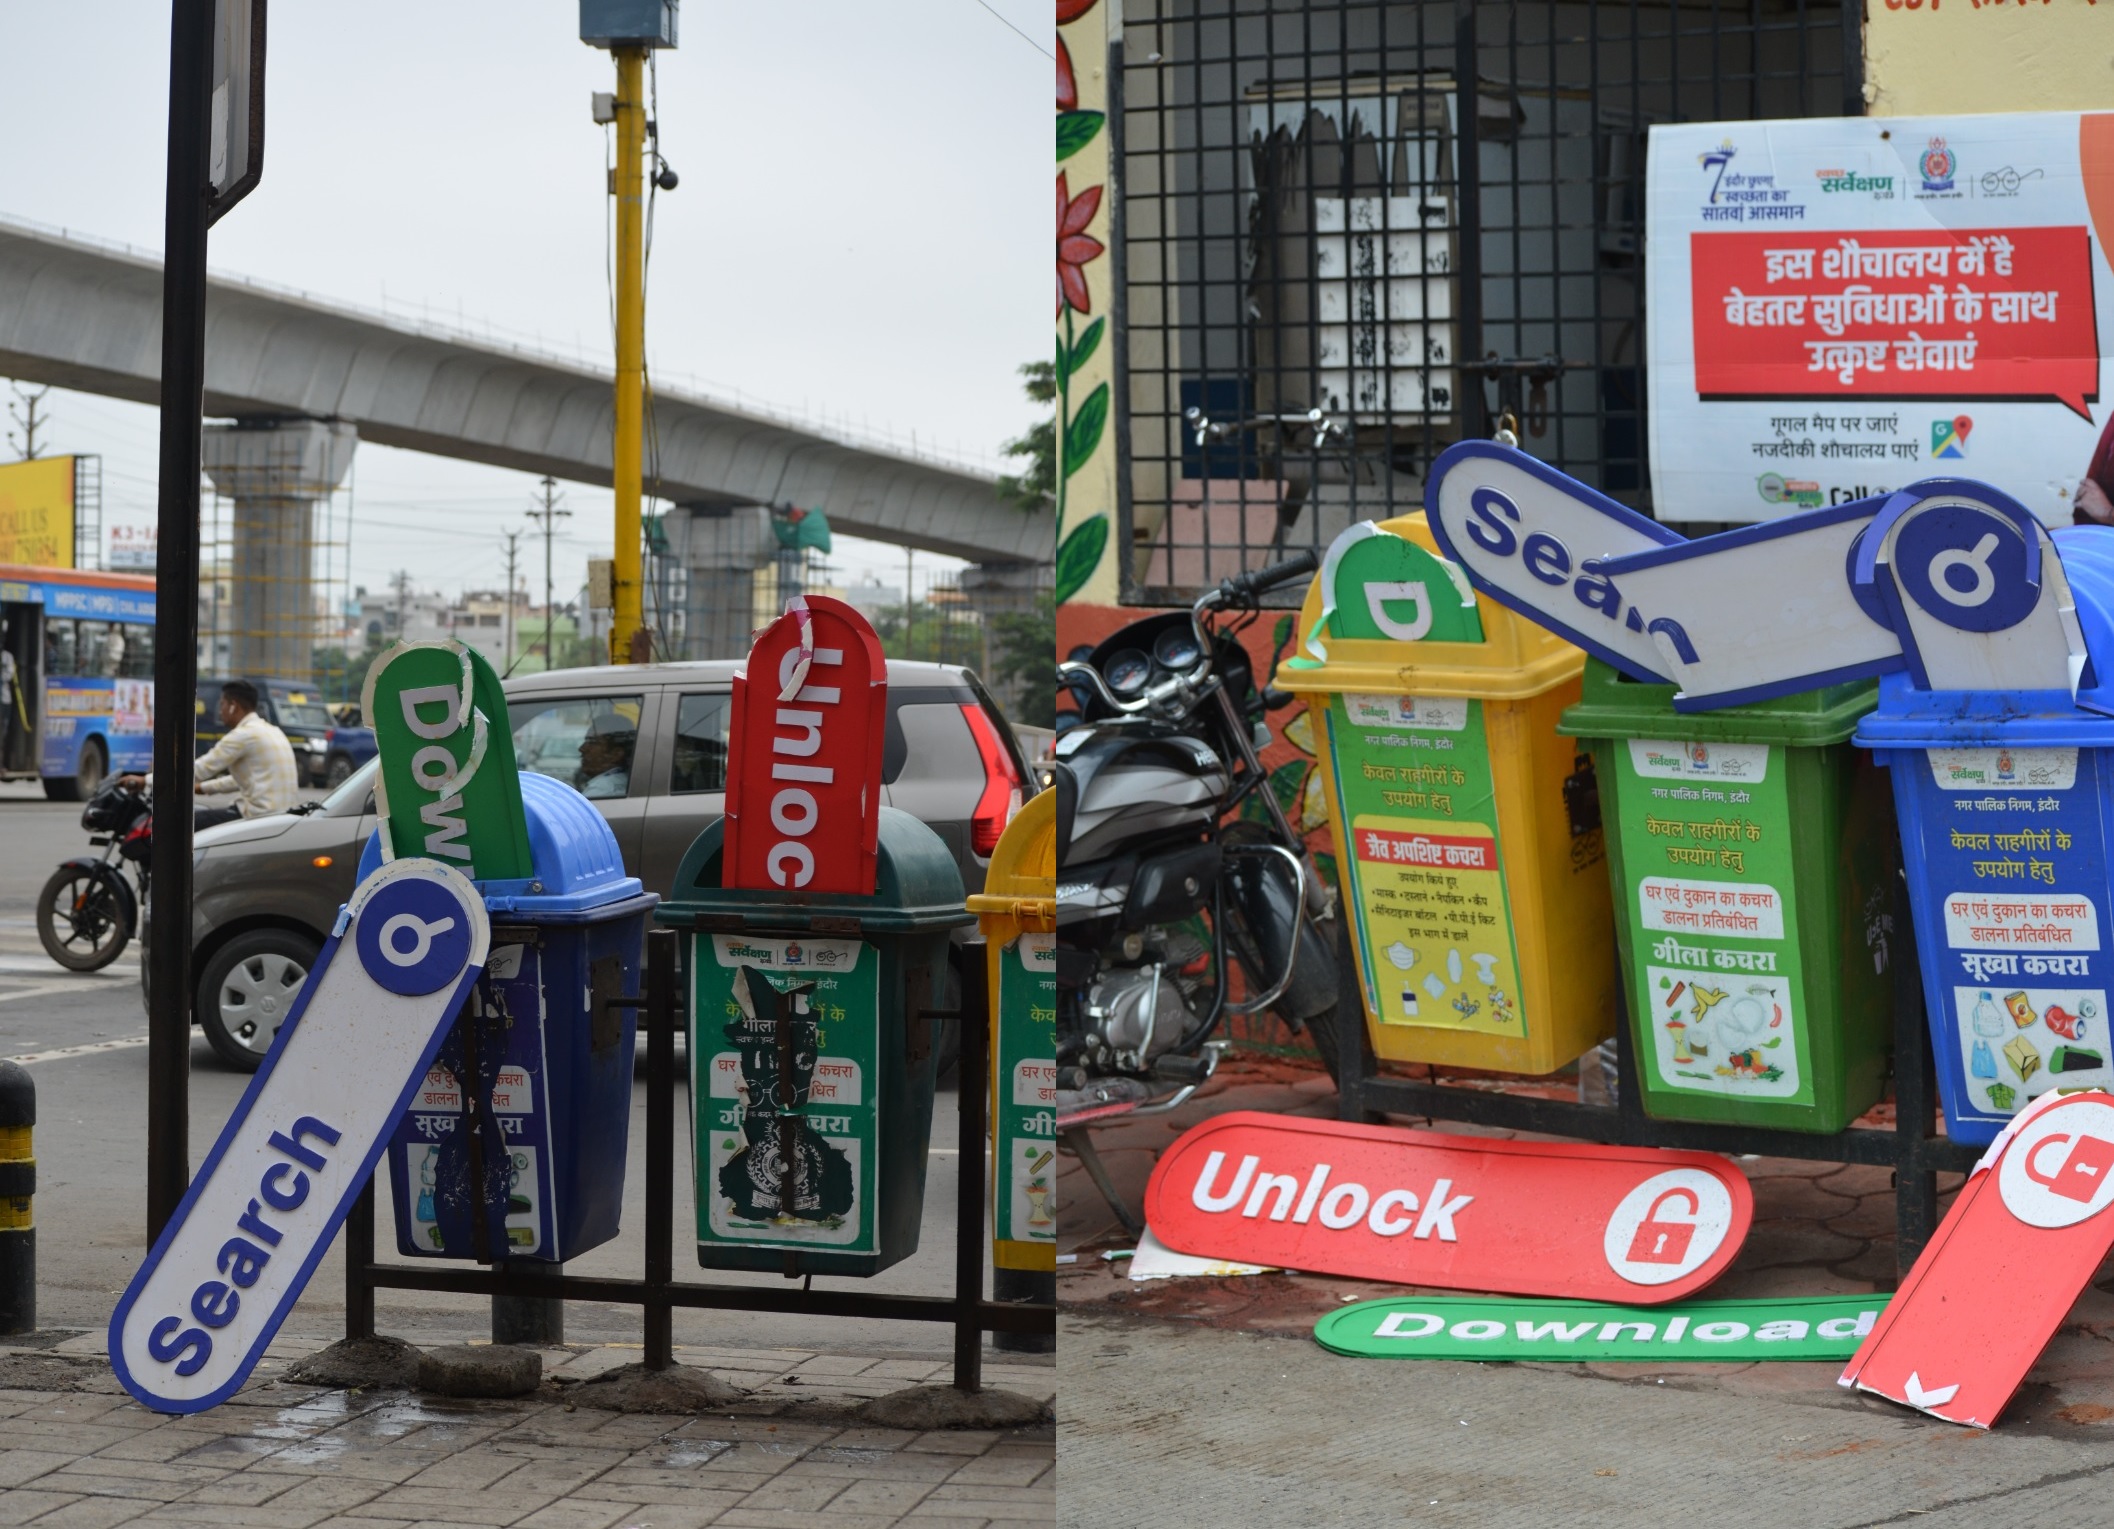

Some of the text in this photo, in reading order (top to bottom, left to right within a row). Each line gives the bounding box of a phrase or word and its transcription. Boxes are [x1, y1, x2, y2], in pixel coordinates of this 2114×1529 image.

[1821, 171, 1894, 193] सर्वेक्षण
[1771, 190, 1790, 202] का
[1748, 204, 1806, 220] आसमान
[1763, 235, 2015, 284] इस शौचालय में है
[1723, 283, 2059, 336] बेहतर सुविधाओं के साथ
[1804, 332, 1978, 385] उत्कृष्ट सेवाएं
[1770, 412, 1899, 436] गूगल मैप पर जाएं
[1752, 438, 1919, 461] नजदीकी शौचालय पाएं
[1361, 759, 1465, 786] केवल राहगीरों के
[1382, 788, 1453, 815] उपयोग हेतु
[1651, 788, 1668, 799] नगर
[1671, 786, 1700, 800] पालिक
[1730, 790, 1751, 804] इंदौर
[1954, 799, 1973, 811] नगर
[1975, 797, 2006, 812] पालिक
[2037, 797, 2060, 812] इंदौर
[1646, 813, 1761, 842] केवल राहगीरों के
[1951, 828, 2072, 852] केवल राहगीरों के
[1366, 833, 1485, 866] जैव अपशिष्ट कचरा
[1667, 844, 1745, 874] उपयोग हेतु
[1973, 857, 2056, 885] उपयोग हेतु
[1645, 884, 1773, 909] घर एवं दुकान का कचरा
[1662, 909, 1758, 931] डालना प्रतिबंधित
[1951, 898, 2087, 923] घर एवं दुकान का कचरा
[1970, 924, 2072, 944] डालना प्रतिबंधित
[1652, 936, 1777, 971] गीला कचरा
[1961, 952, 2089, 982] सूखा कचरा
[830, 1003, 846, 1022] के
[718, 1059, 853, 1078] घर कचरा
[1021, 1066, 1039, 1079] घर
[424, 1092, 459, 1106] डालना
[1191, 1151, 1475, 1243] Unlock
[148, 1115, 342, 1376] Search
[1372, 1312, 1878, 1344] Download
